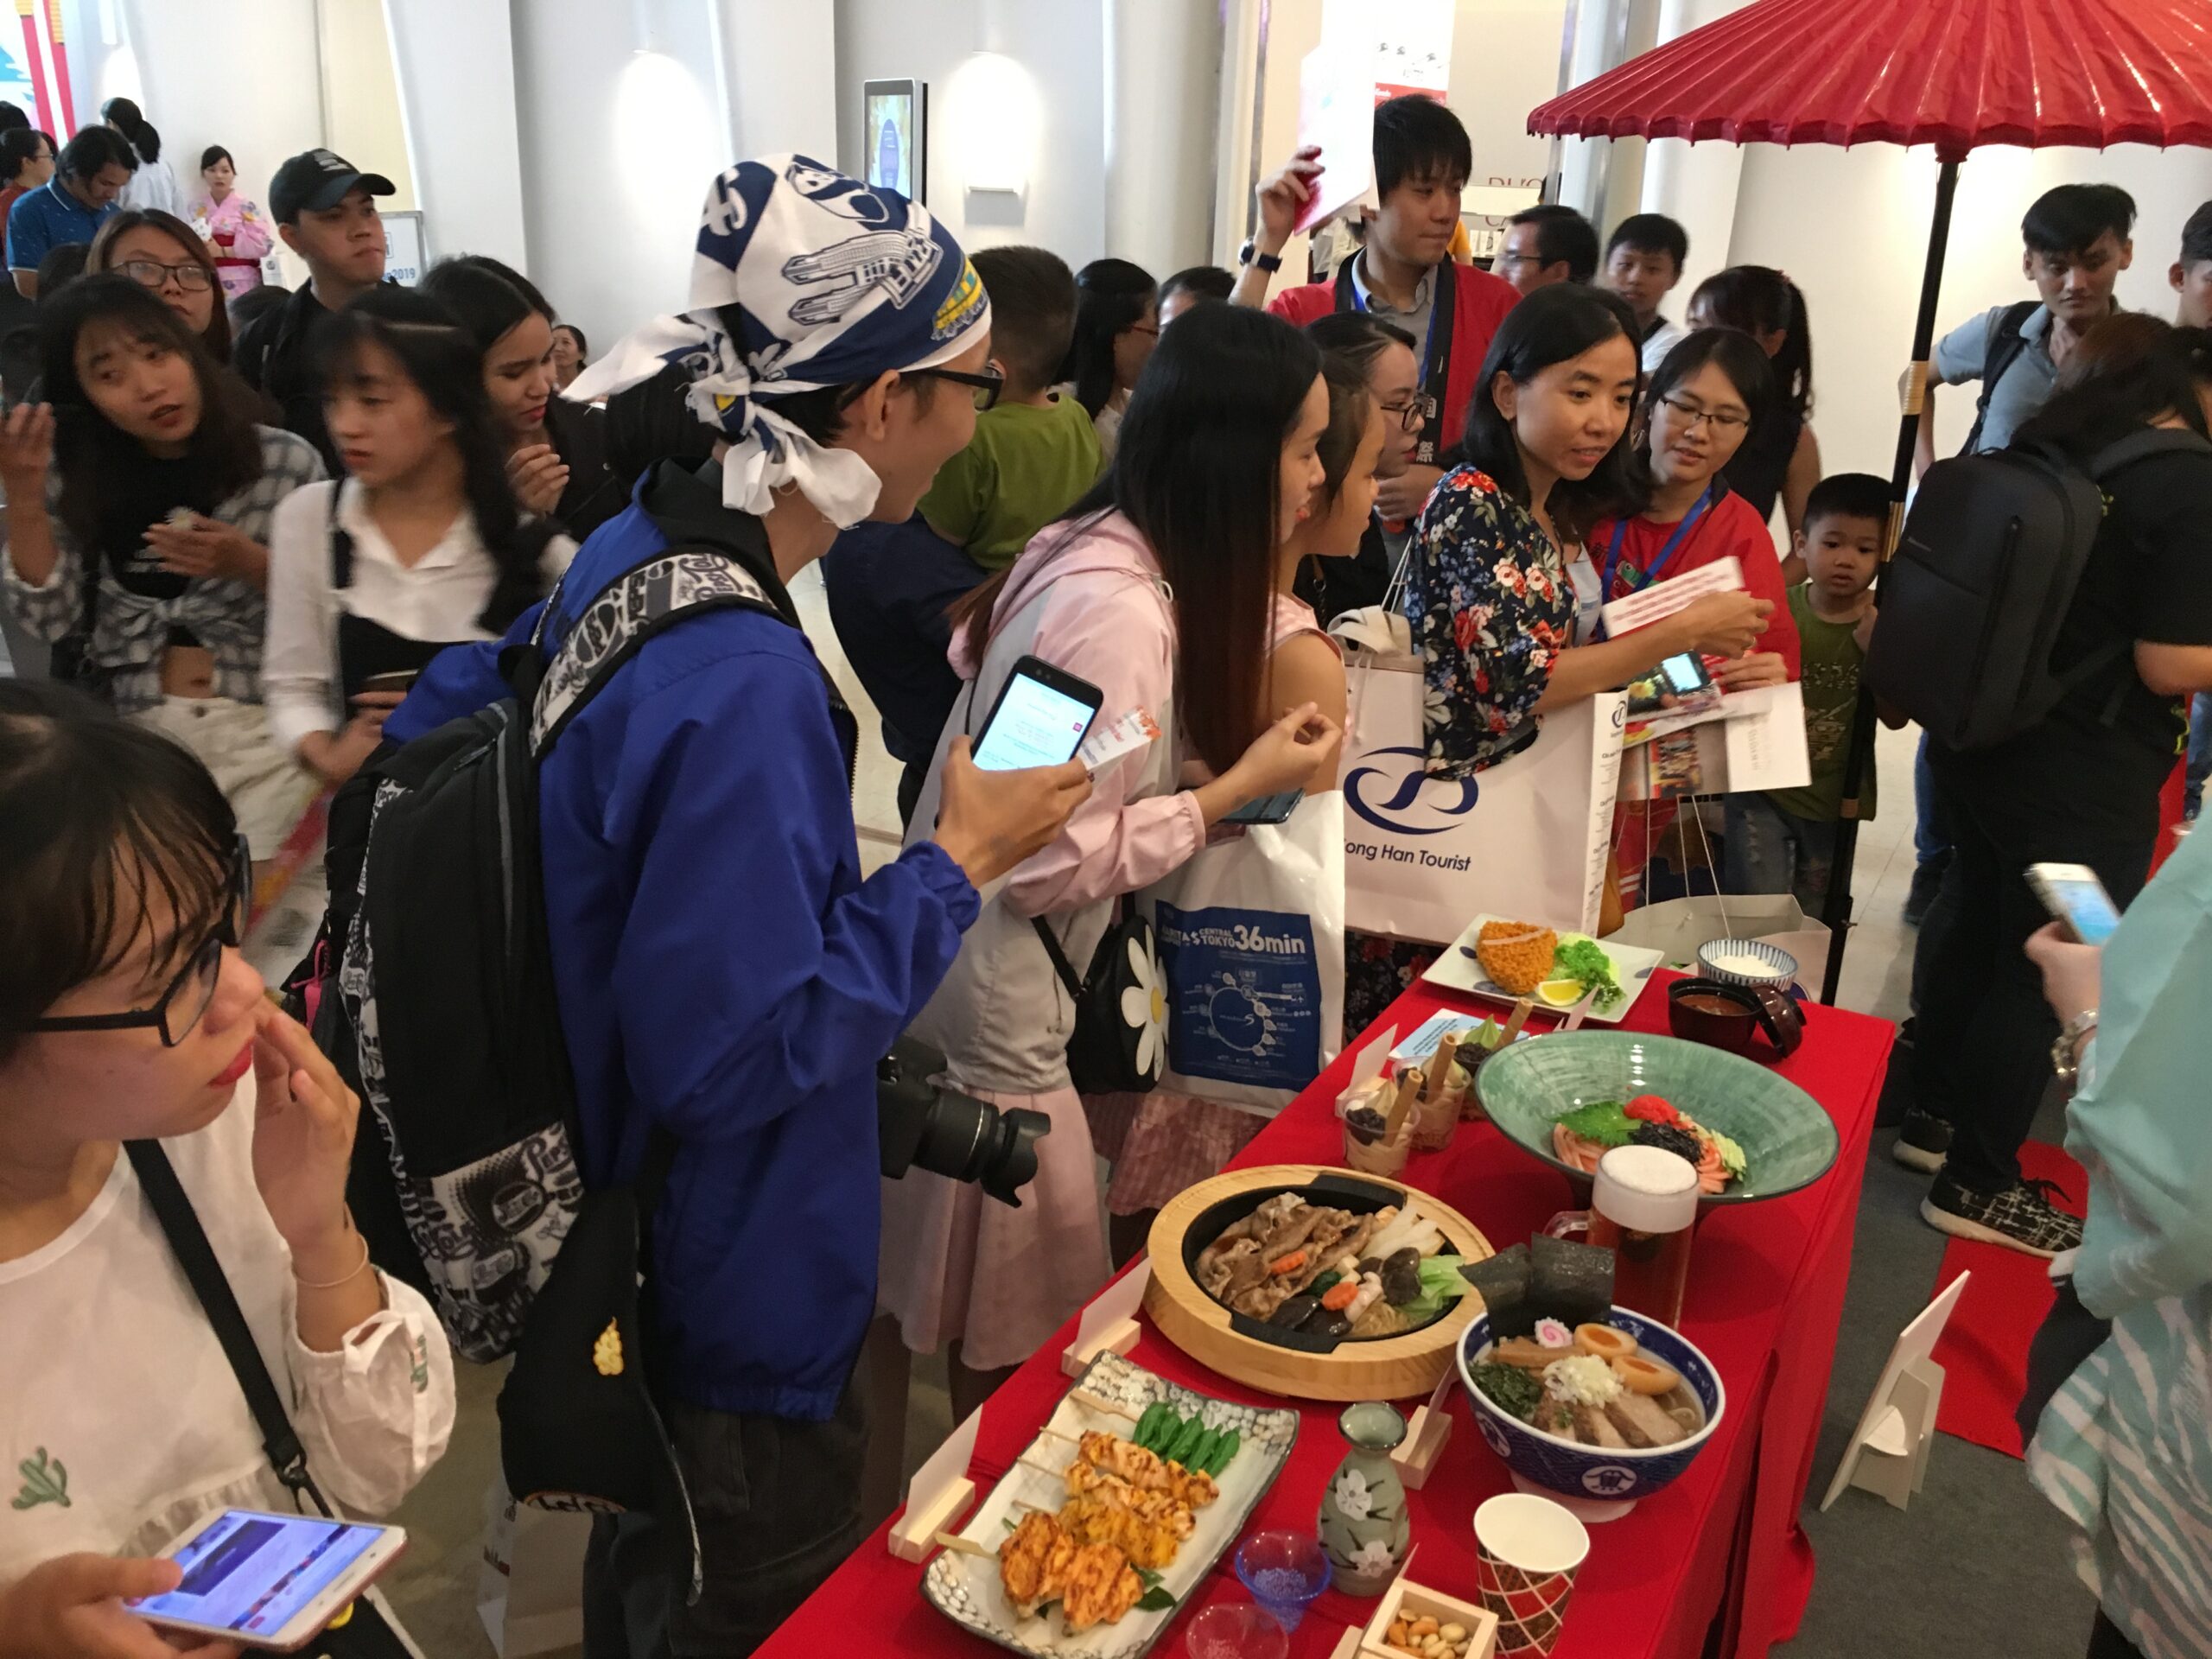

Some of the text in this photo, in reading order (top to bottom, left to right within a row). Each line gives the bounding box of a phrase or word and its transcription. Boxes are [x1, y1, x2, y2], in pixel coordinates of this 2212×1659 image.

[1344, 839, 1471, 872] ong Han Tourist
[1198, 927, 1233, 938] CENTRAL
[1200, 935, 1236, 948] TOKYO
